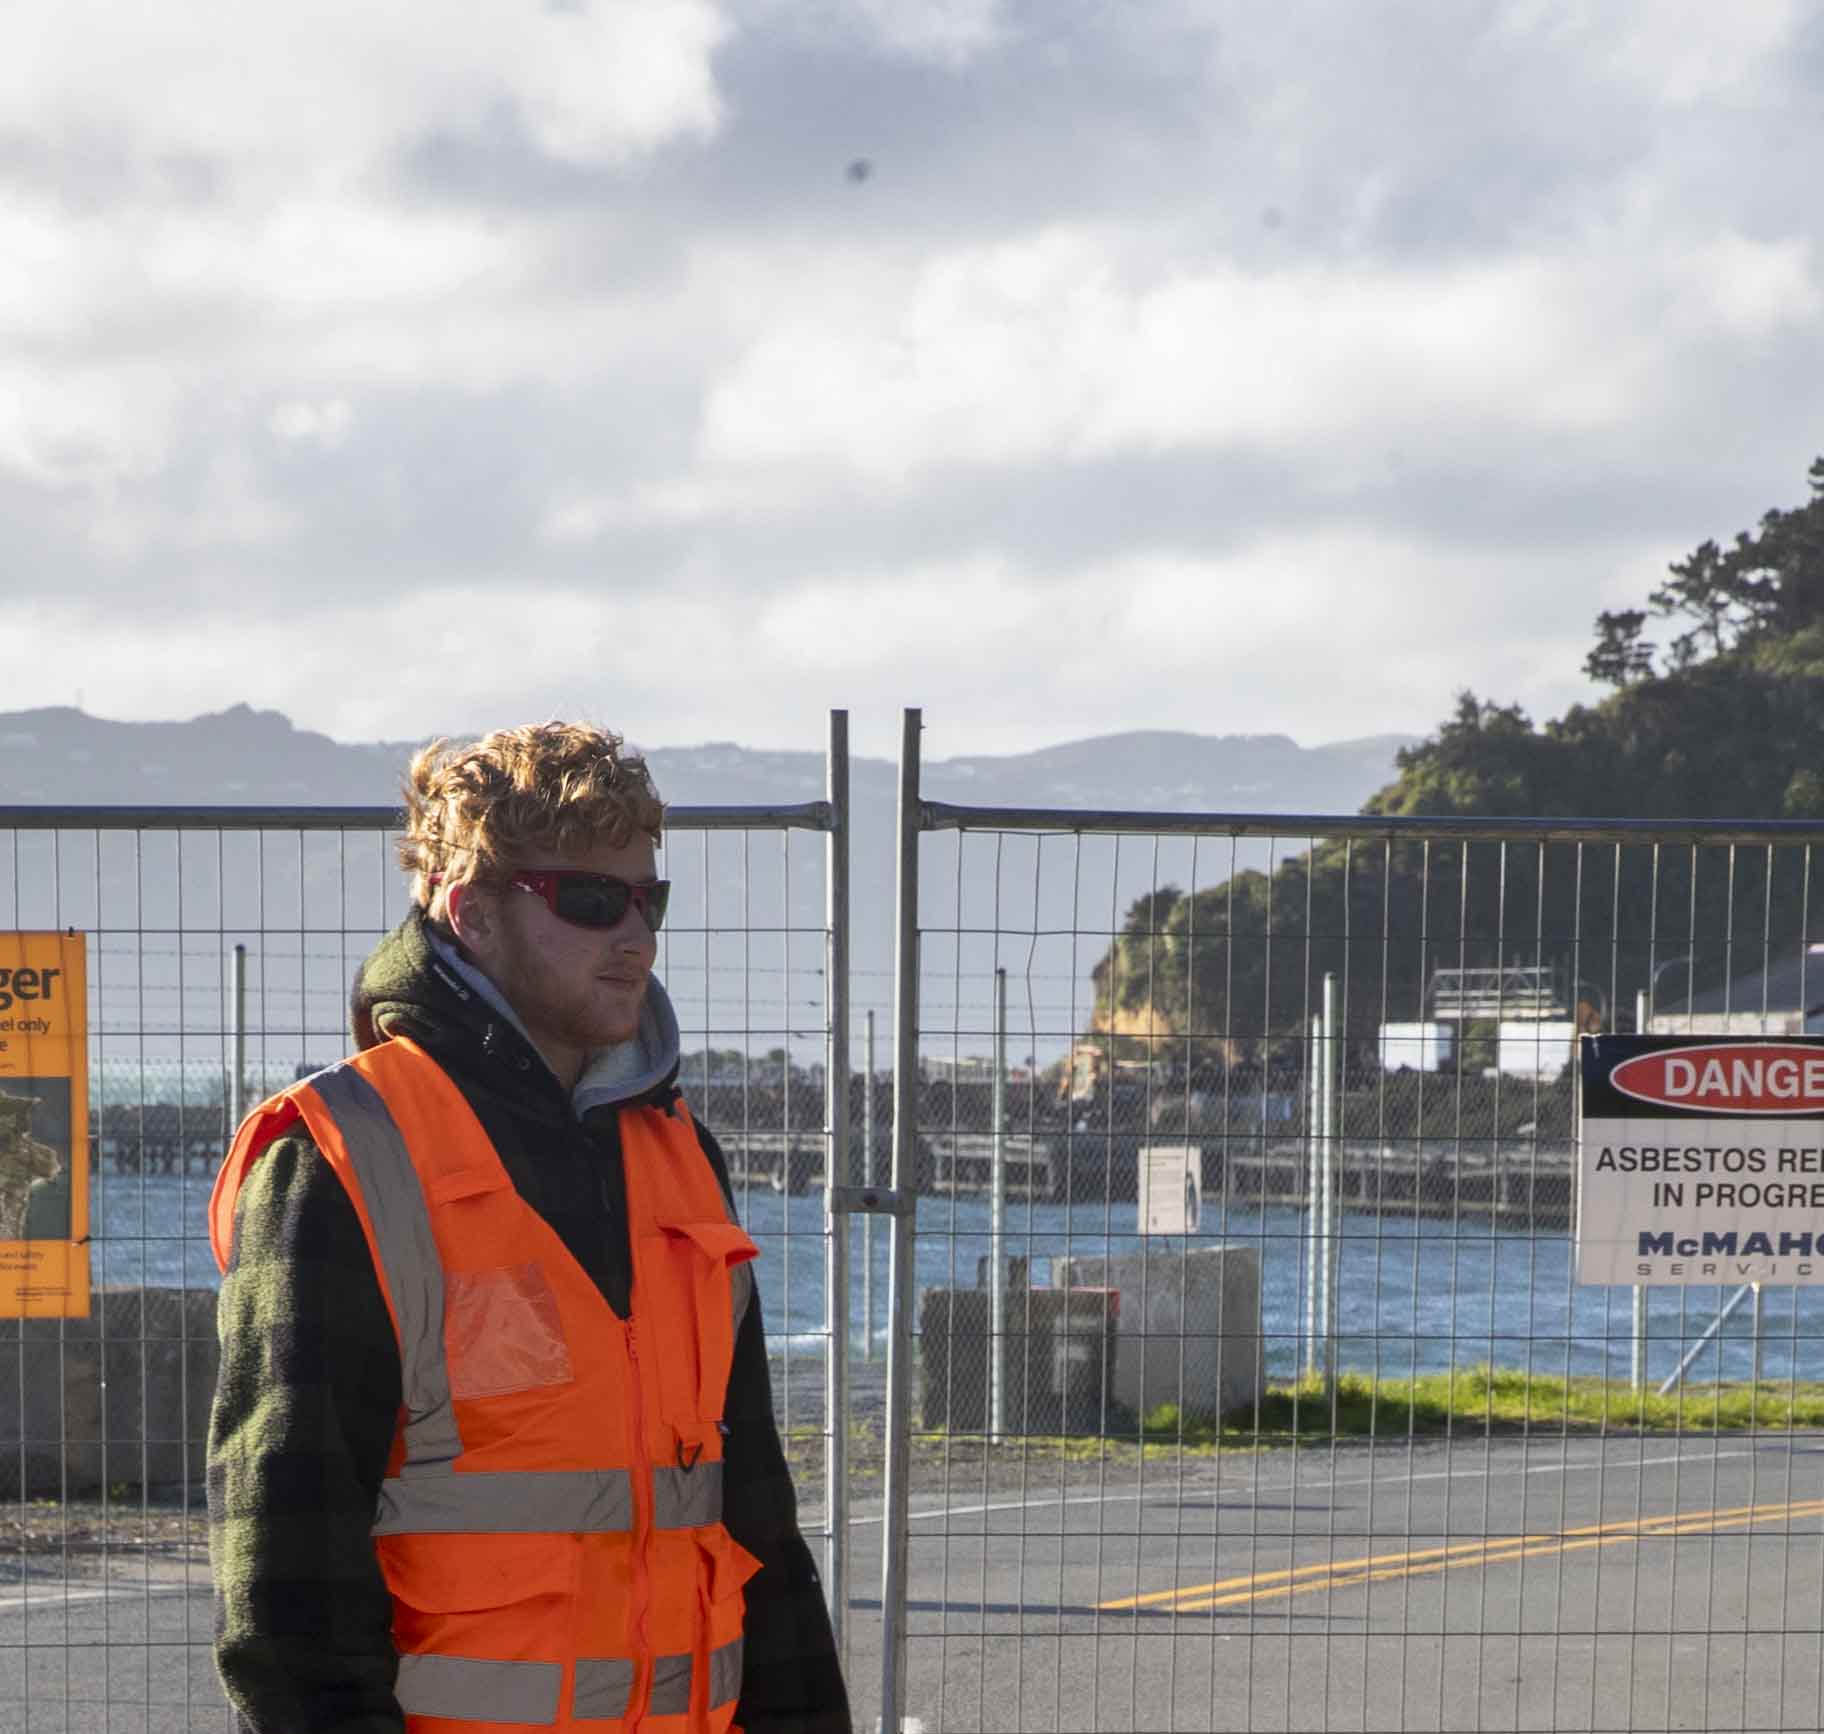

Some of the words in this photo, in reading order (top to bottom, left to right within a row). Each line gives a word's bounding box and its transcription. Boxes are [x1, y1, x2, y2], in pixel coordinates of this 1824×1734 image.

[17, 1018, 51, 1034] only
[1596, 1147, 1767, 1173] ASBESTOS
[1653, 1184, 1684, 1208] IN
